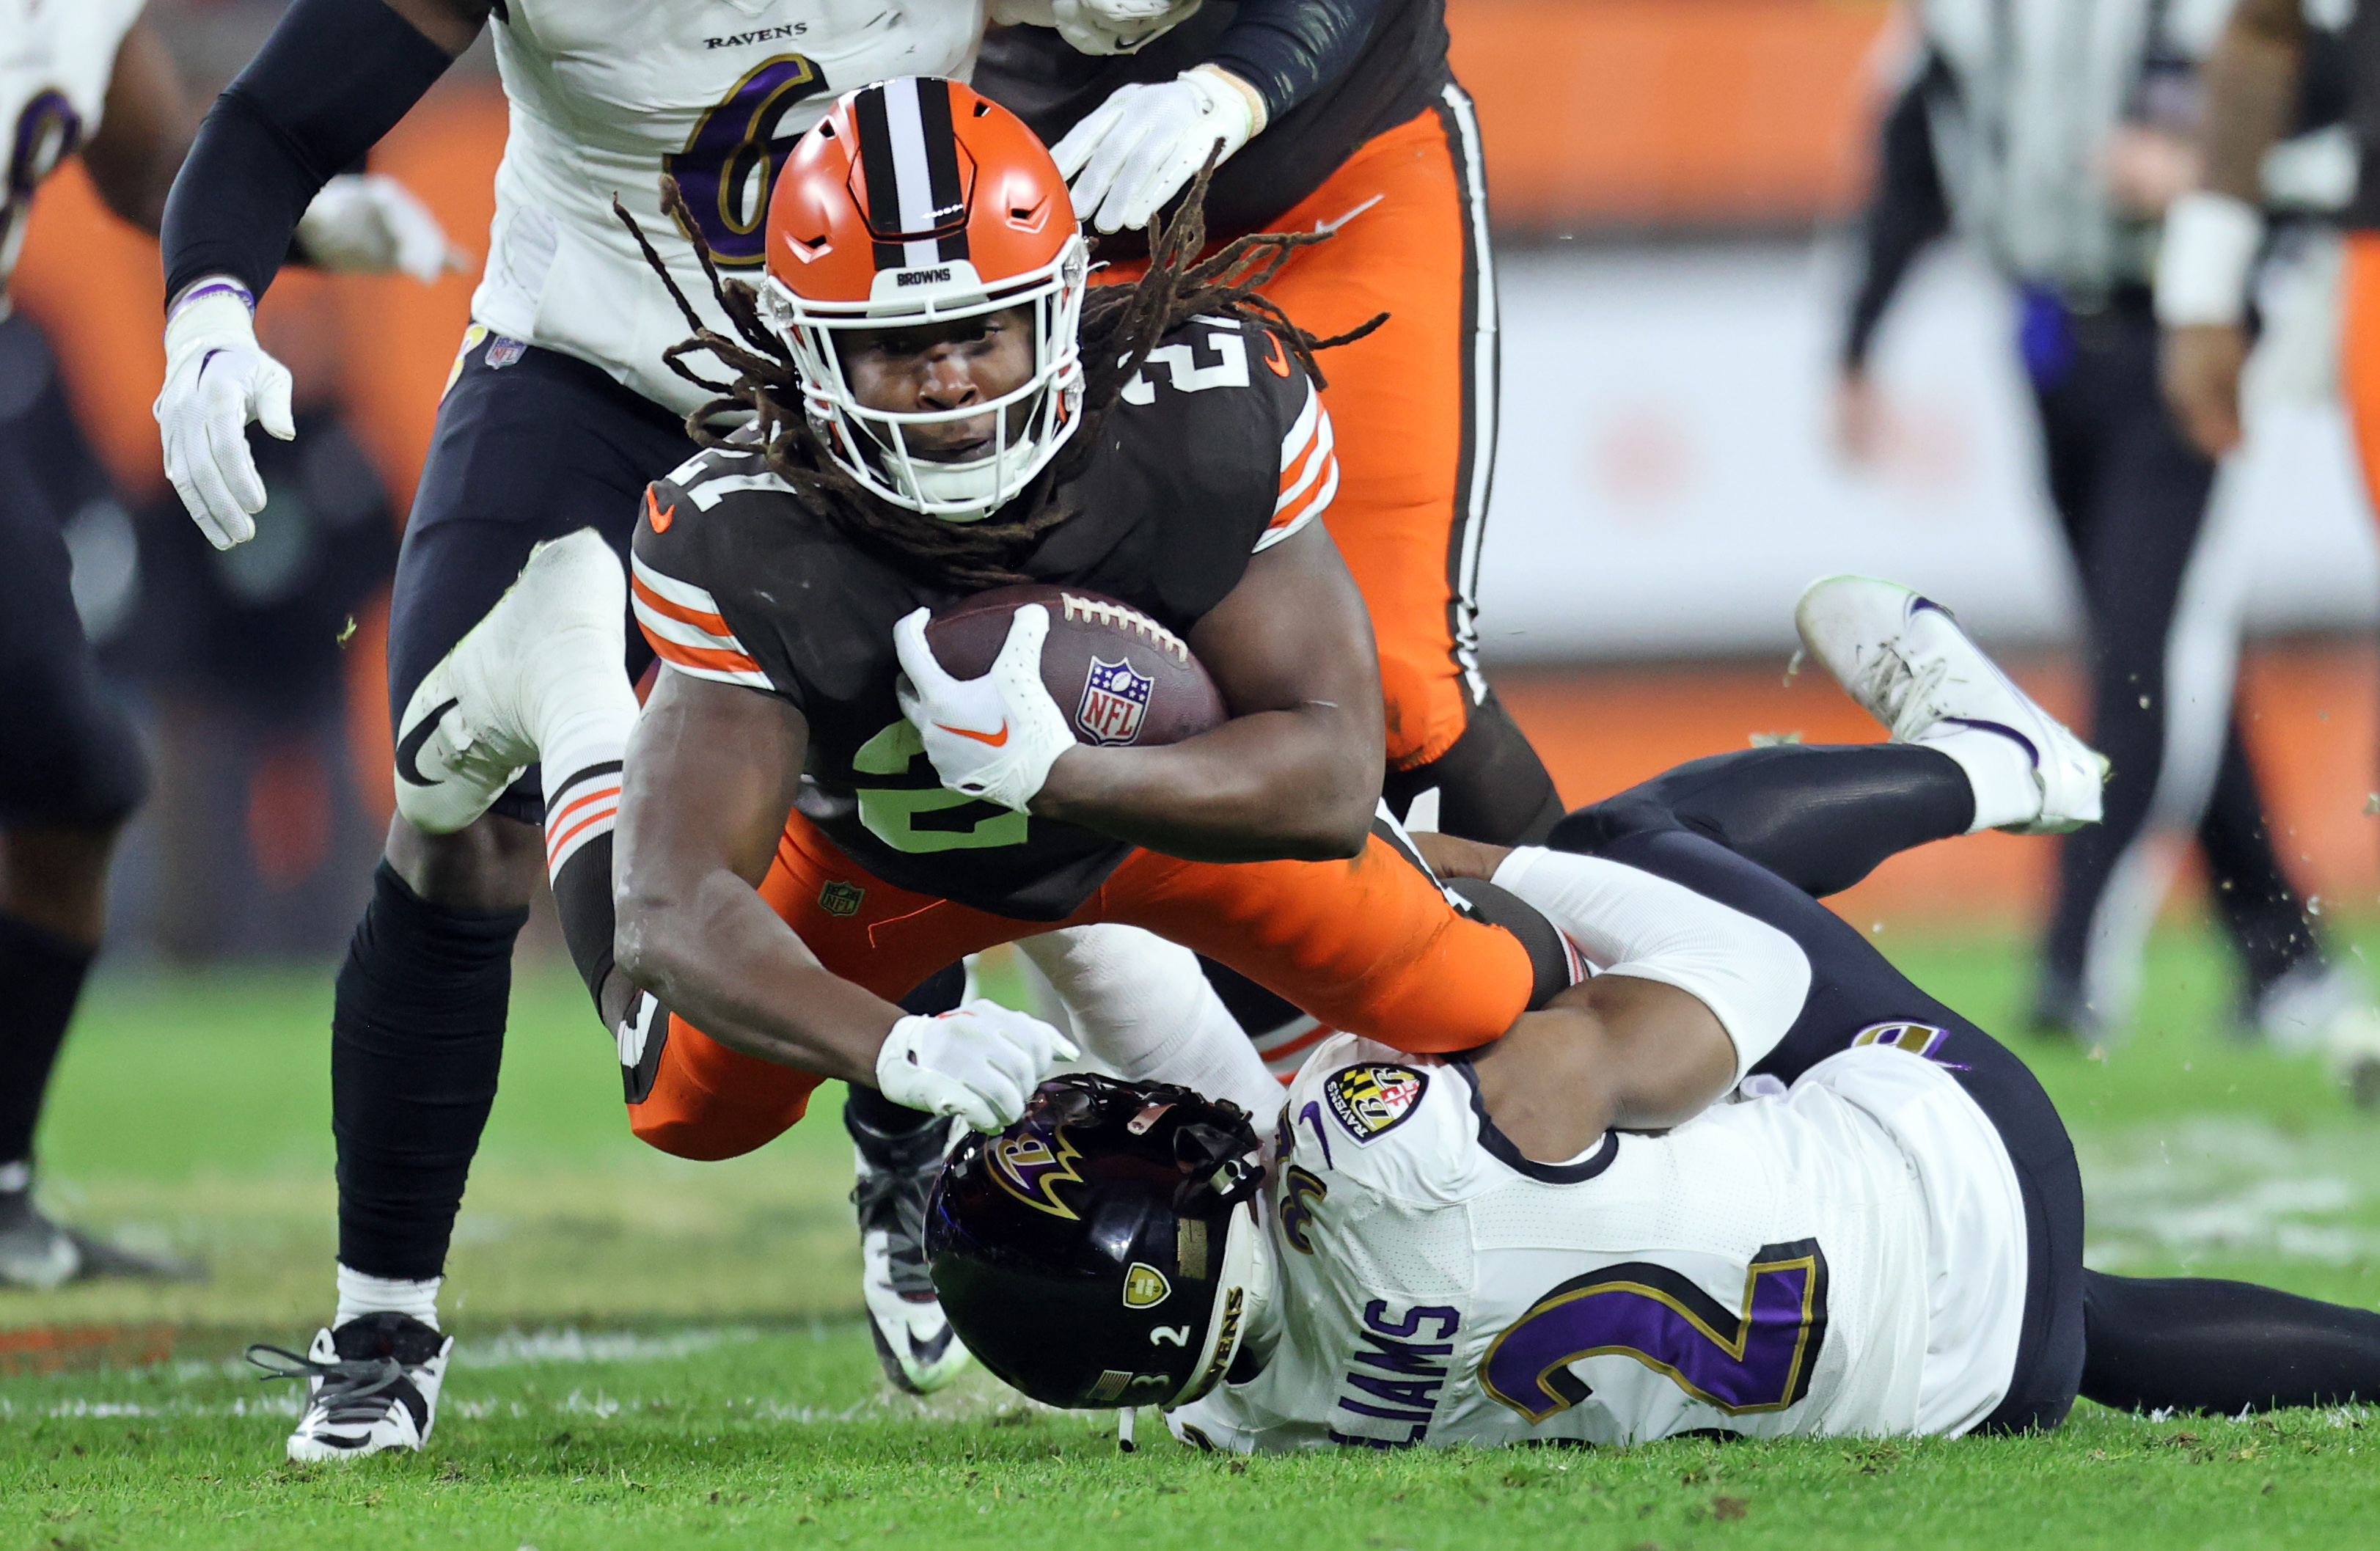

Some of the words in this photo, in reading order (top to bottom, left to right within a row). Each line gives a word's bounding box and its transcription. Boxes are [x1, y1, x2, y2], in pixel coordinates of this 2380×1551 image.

[703, 22, 808, 49] RAVENS
[662, 53, 830, 271] 6
[896, 268, 951, 287] BROWNS
[1083, 690, 1135, 736] NFL
[822, 893, 854, 913] NFL
[1328, 1081, 1369, 1137] RAVENS
